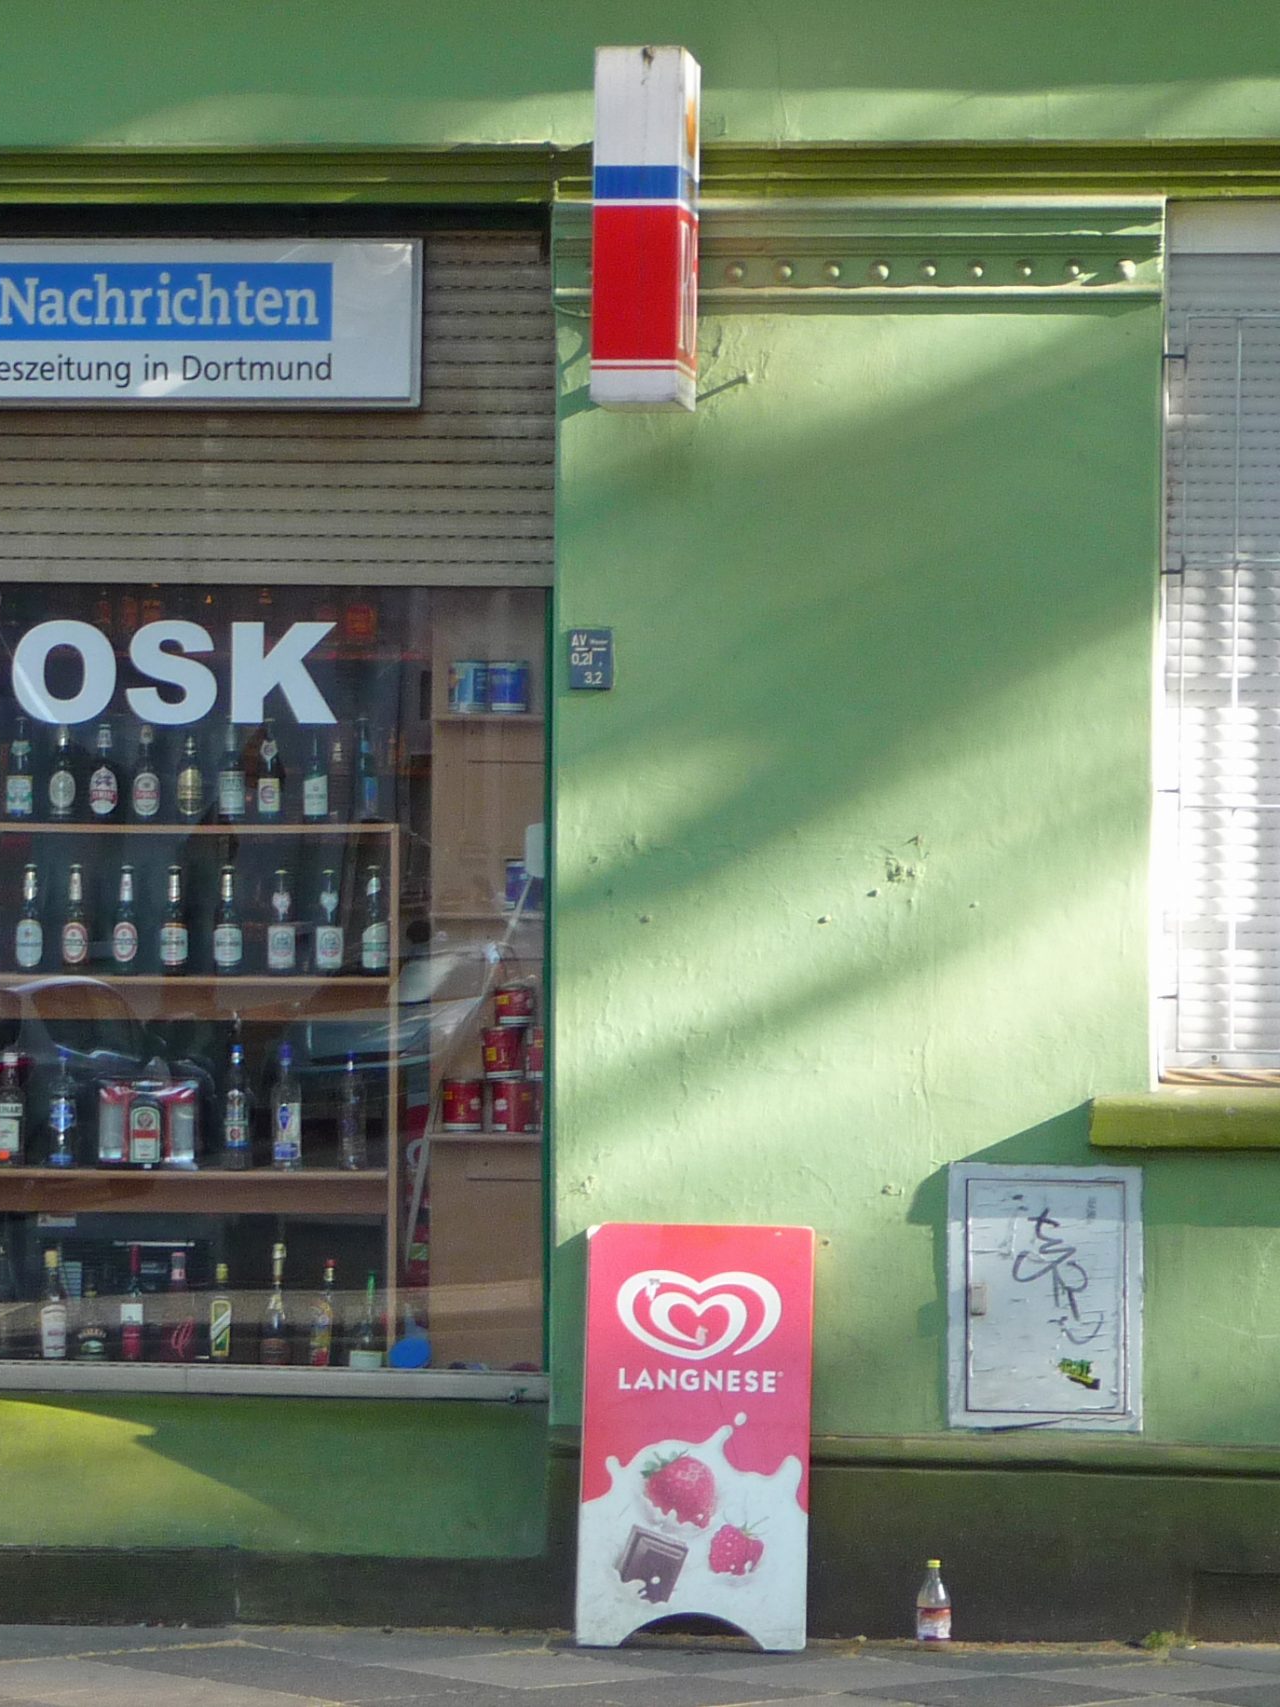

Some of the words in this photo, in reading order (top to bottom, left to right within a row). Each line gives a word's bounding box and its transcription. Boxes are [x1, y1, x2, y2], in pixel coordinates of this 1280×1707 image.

[144, 354, 168, 382] in
[181, 353, 333, 382] Dortmund
[618, 1366, 777, 1394] LANGNESE
